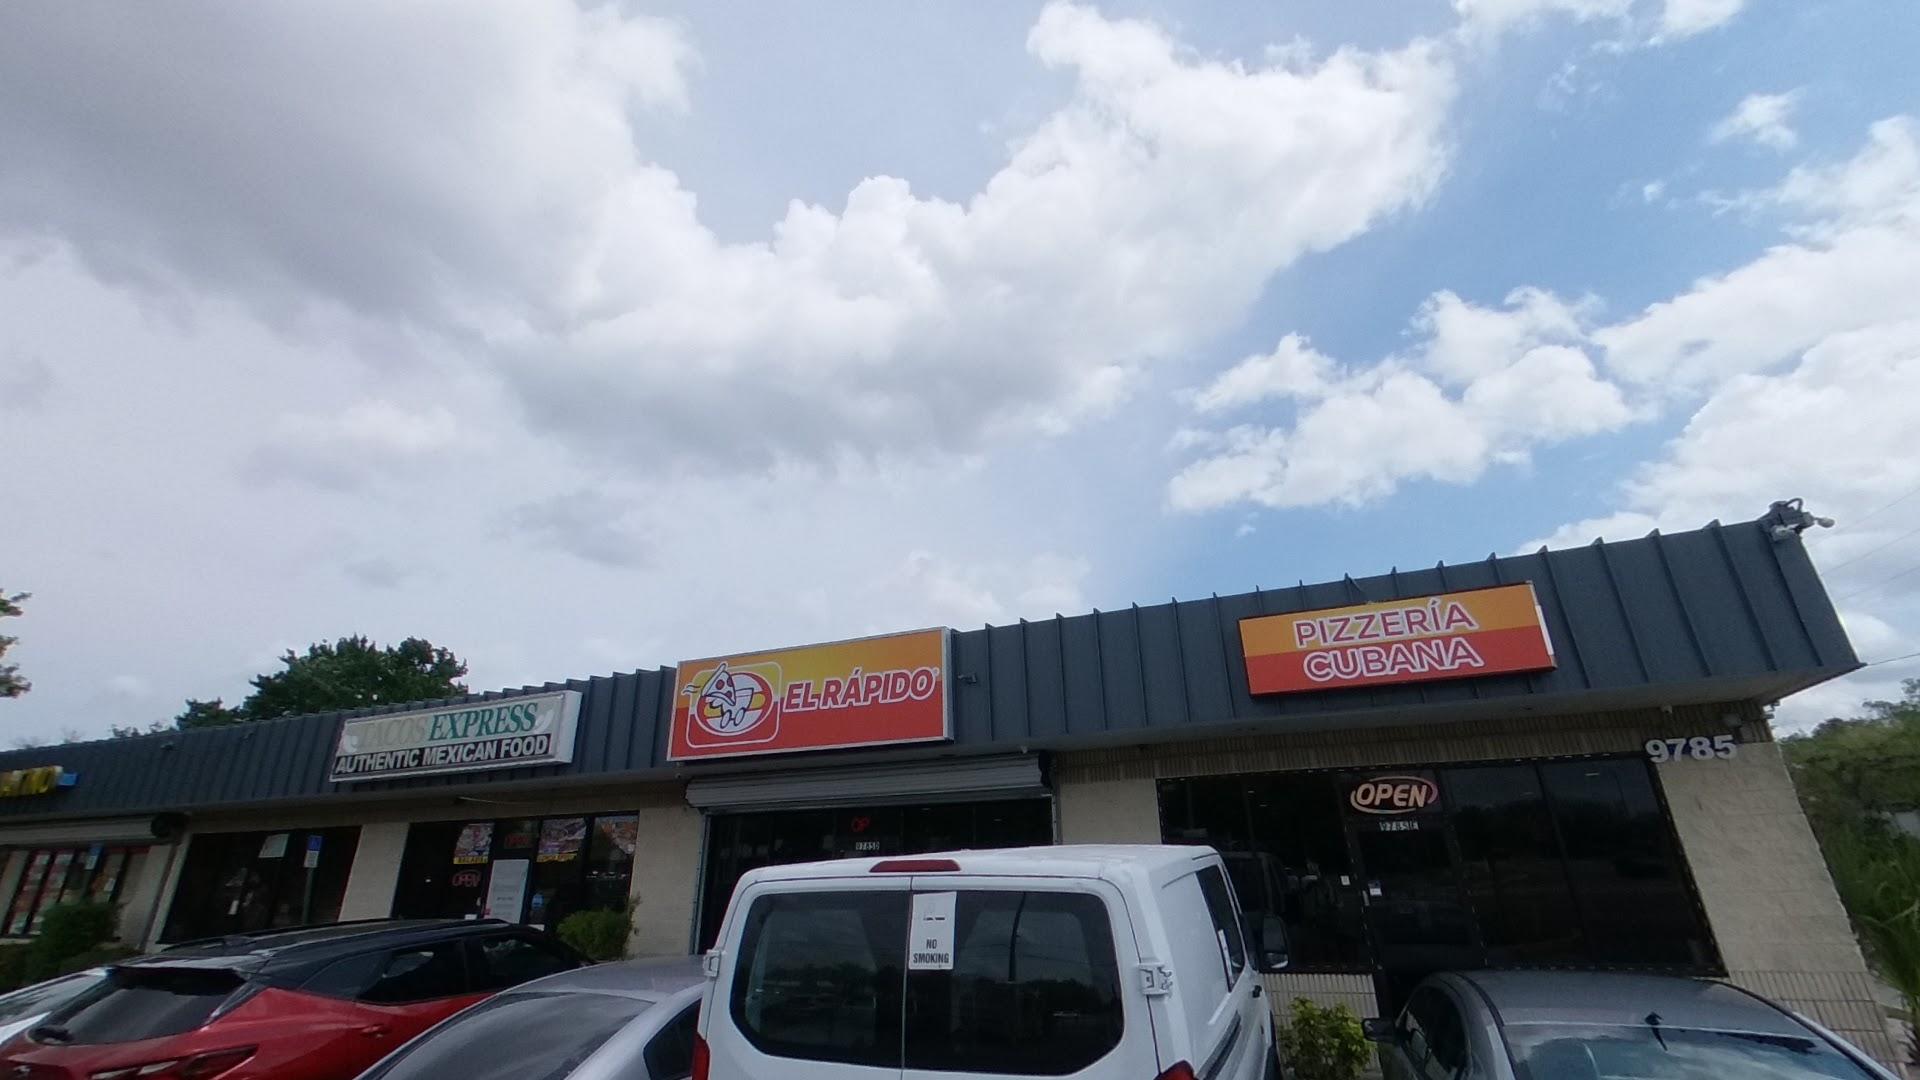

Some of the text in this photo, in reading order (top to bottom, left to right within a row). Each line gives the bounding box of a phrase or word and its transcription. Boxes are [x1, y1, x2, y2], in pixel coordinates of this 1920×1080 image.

[1294, 598, 1478, 648] PIZZERÍA
[1304, 637, 1484, 682] CUBANA
[783, 667, 936, 712] EL RÁPIDO
[428, 702, 538, 741] EXPRESS
[335, 735, 549, 774] AUTHENTIC MEXICAN FOOD
[1645, 734, 1738, 763] 9785
[1356, 783, 1427, 808] OPEN
[913, 953, 949, 964] SMOKING
[926, 939, 938, 949] NO
